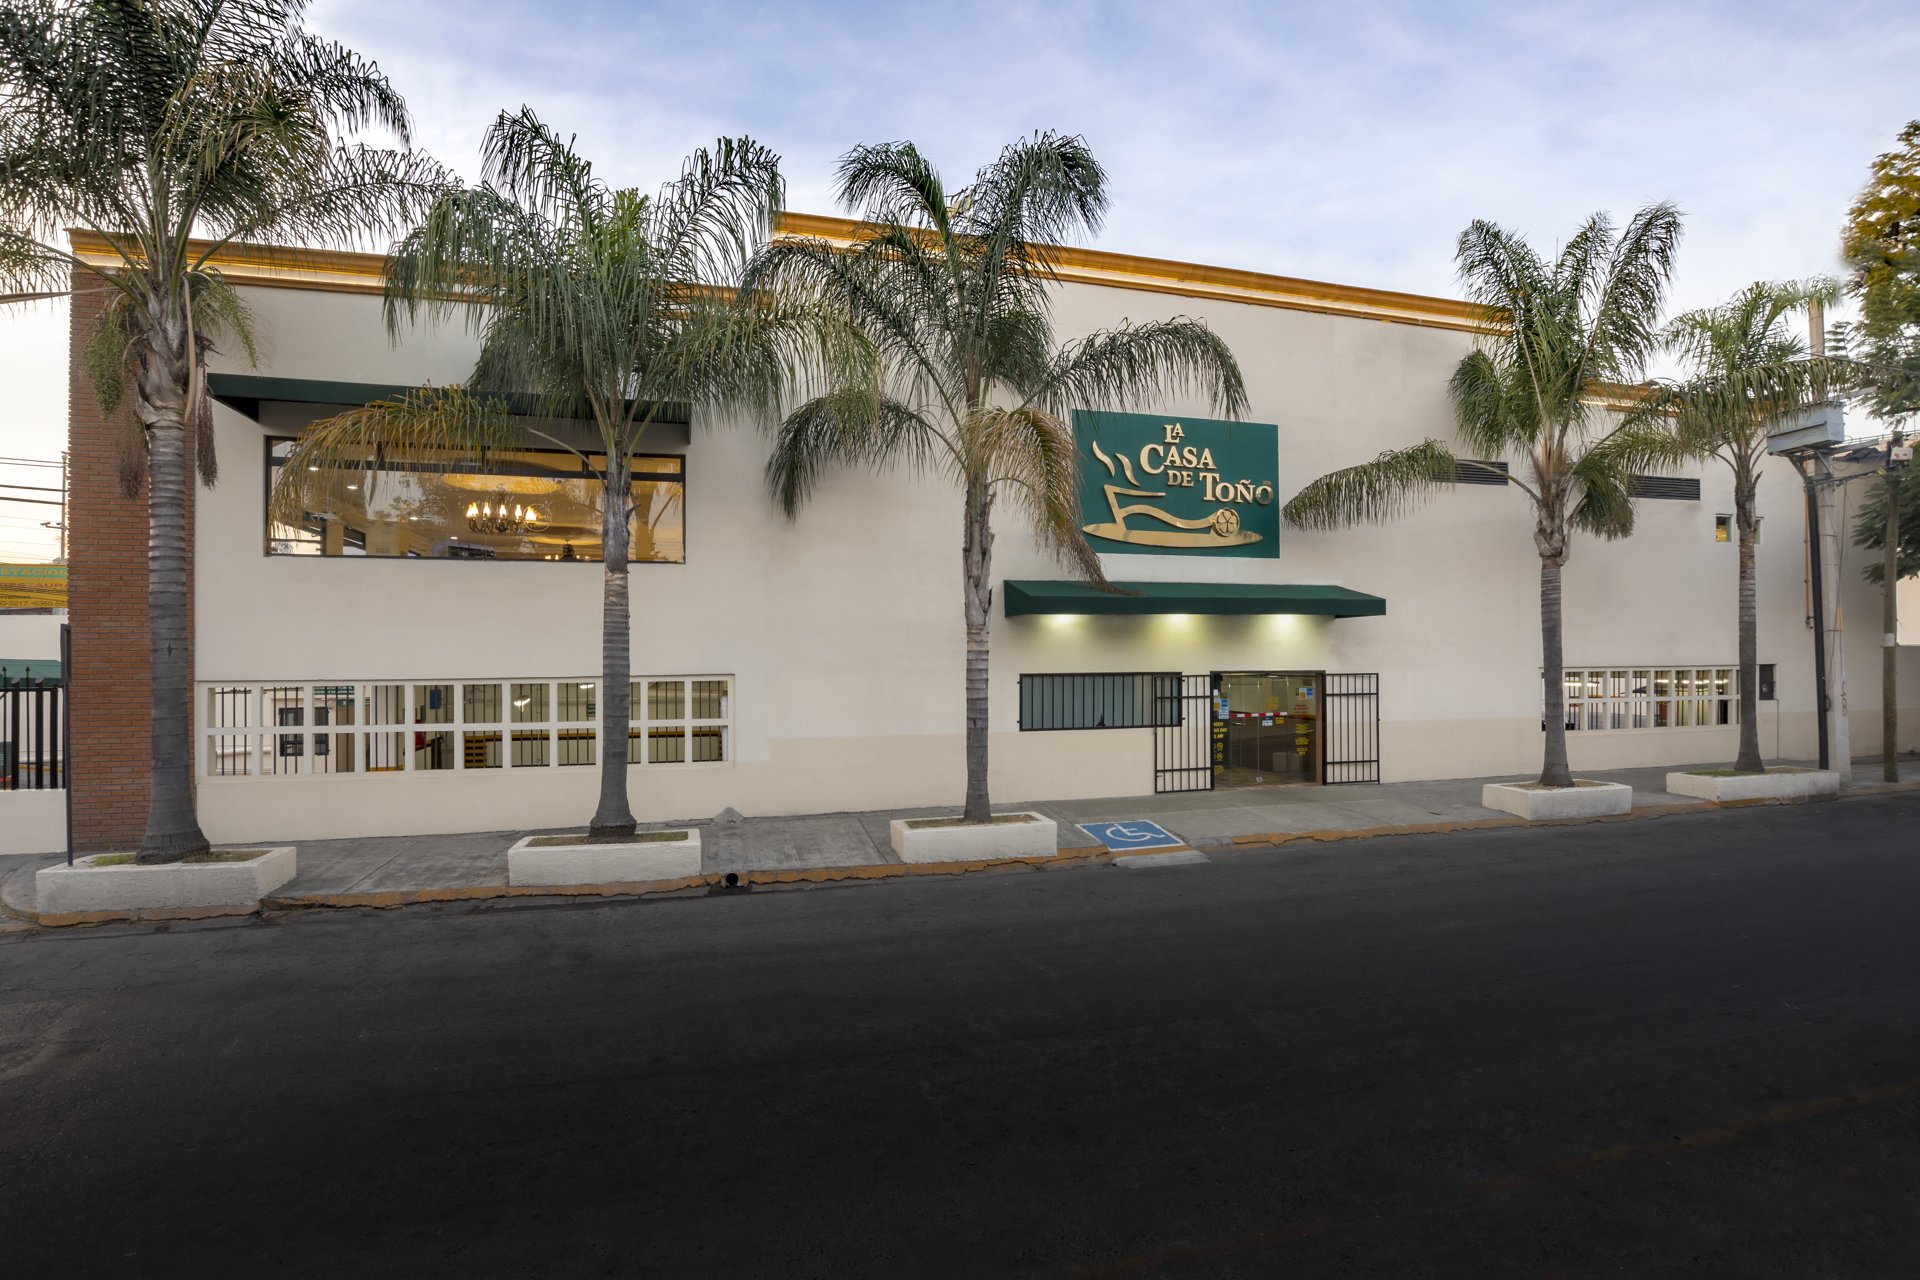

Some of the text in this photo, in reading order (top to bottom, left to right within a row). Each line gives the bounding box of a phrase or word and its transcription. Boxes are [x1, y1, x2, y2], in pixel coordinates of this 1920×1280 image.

[1164, 423, 1185, 443] LA
[1140, 444, 1216, 475] CASA
[1167, 470, 1274, 505] DE TOÑO
